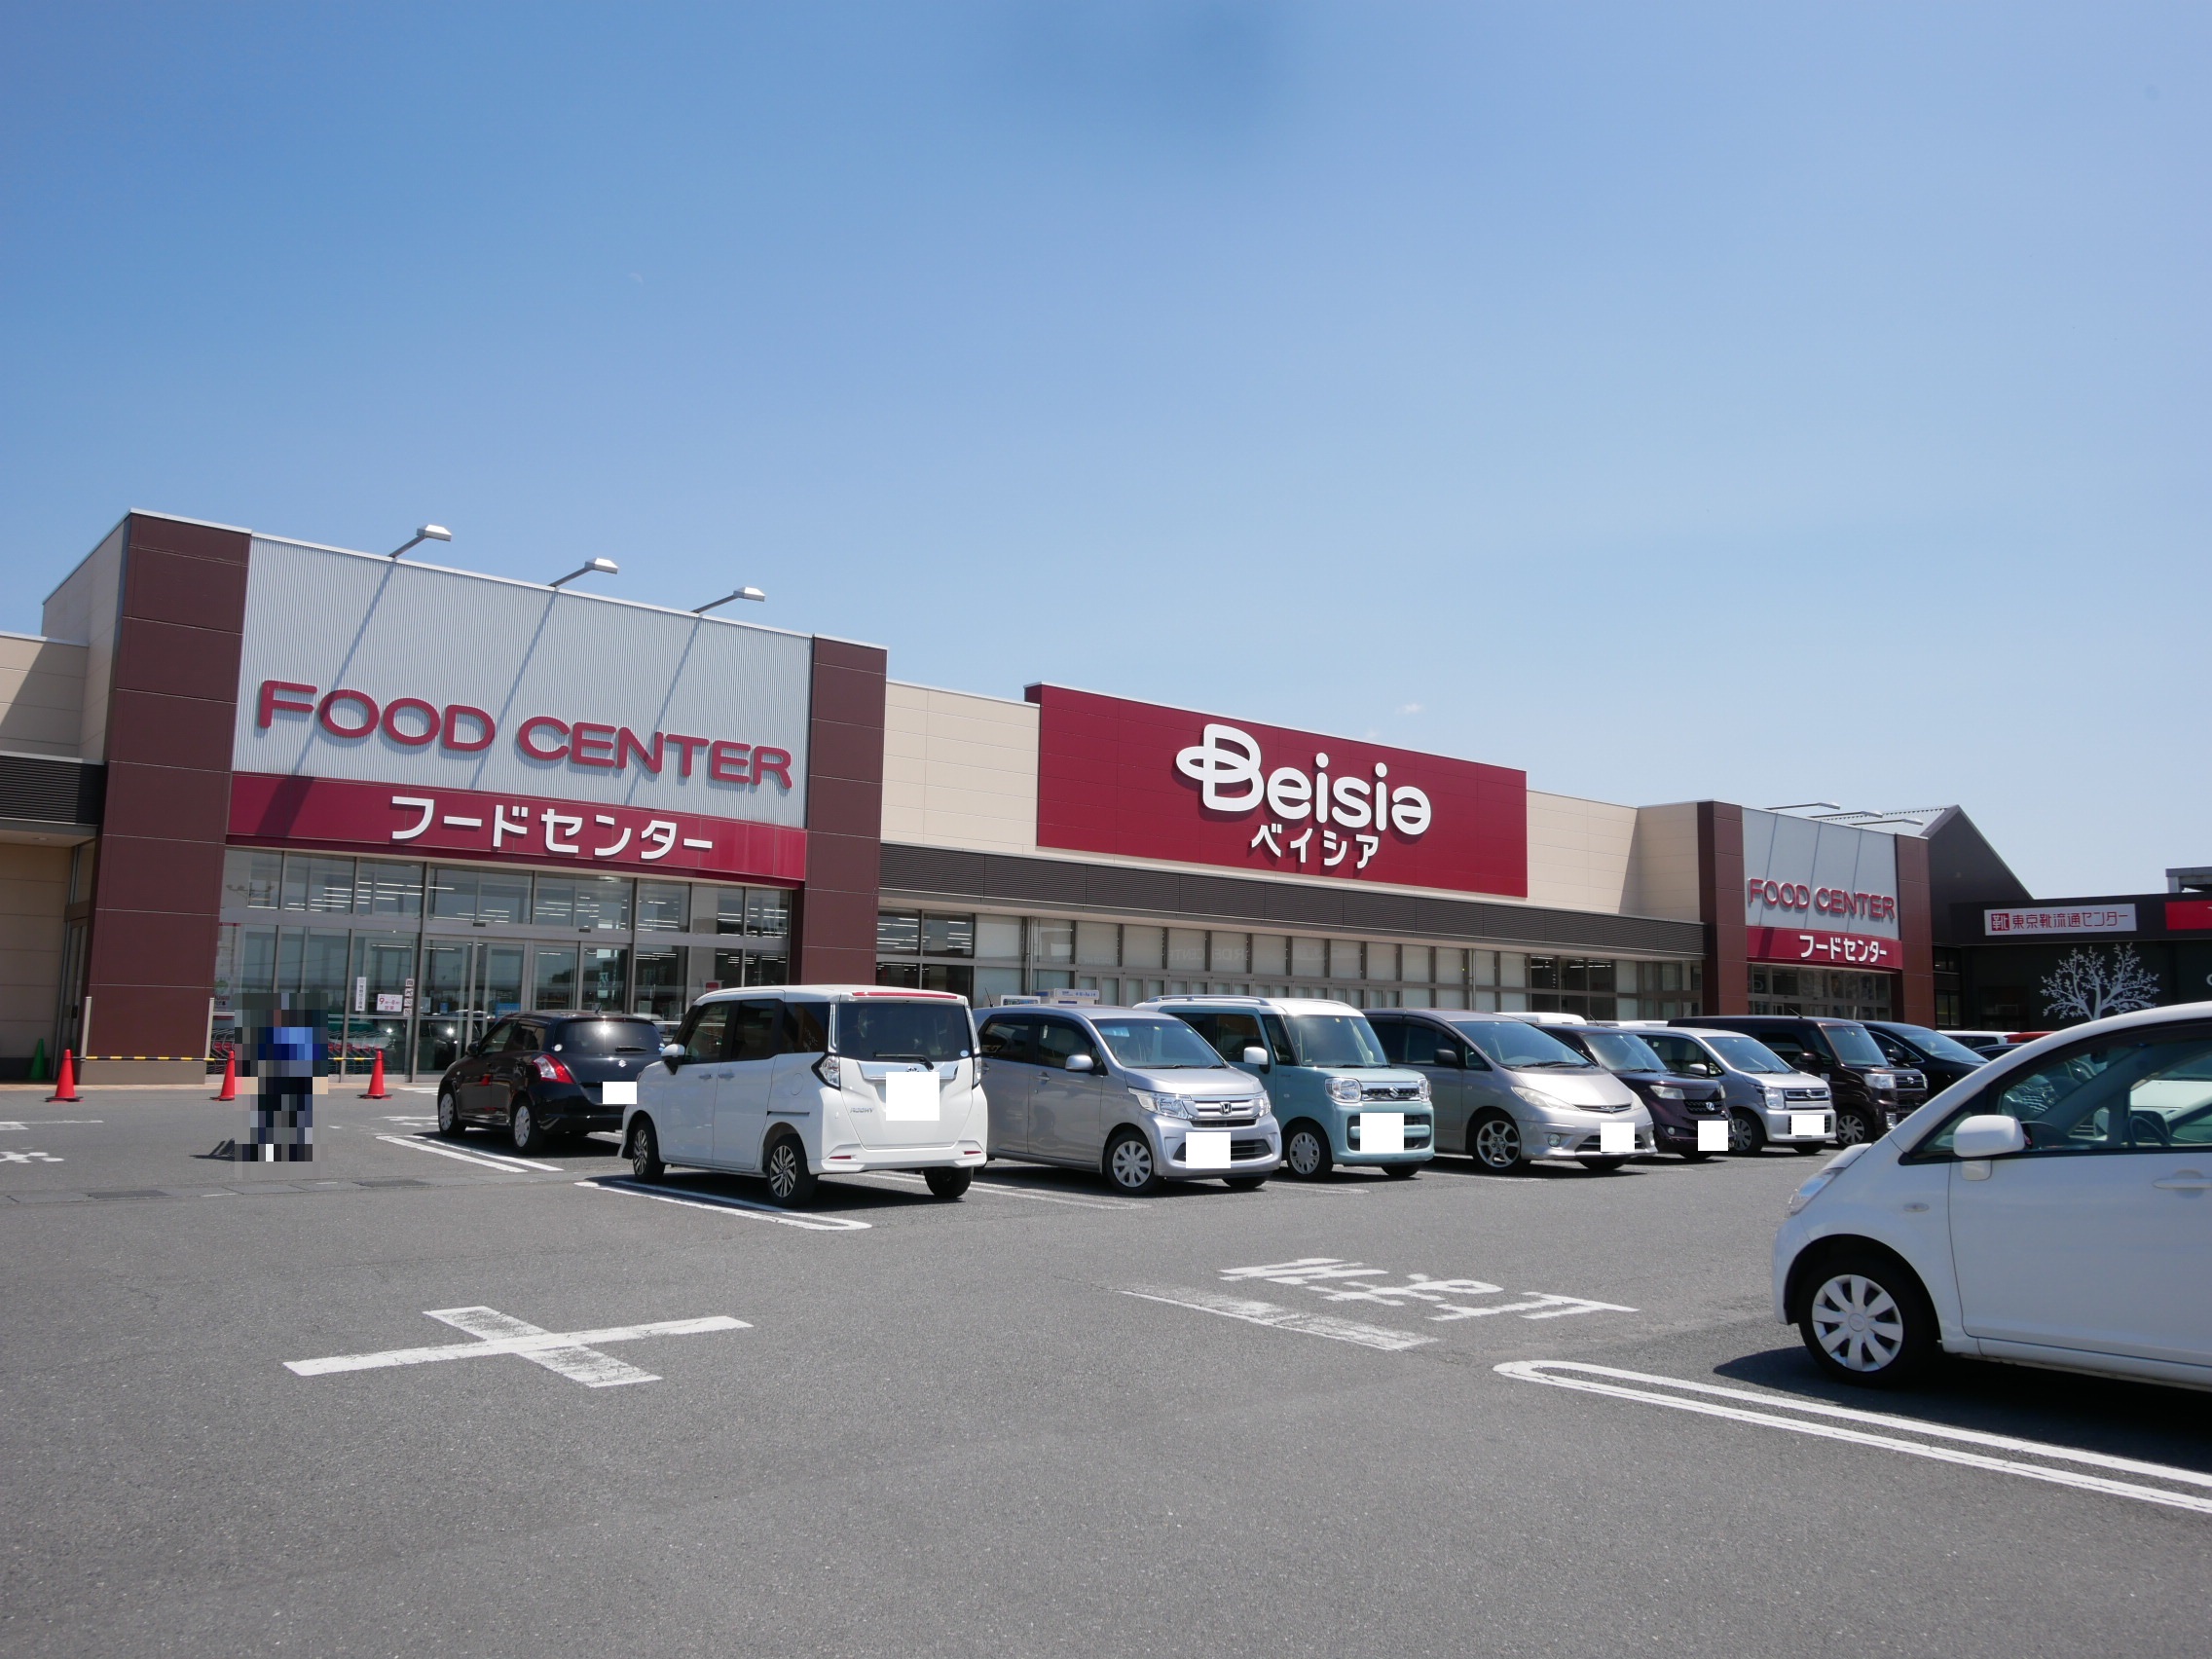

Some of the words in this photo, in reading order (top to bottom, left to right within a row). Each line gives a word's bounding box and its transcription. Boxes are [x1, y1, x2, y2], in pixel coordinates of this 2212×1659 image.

[257, 680, 496, 752] FOOD
[517, 716, 793, 790] CENTER
[1176, 723, 1432, 835] Beisia
[391, 795, 713, 860] フードセンター
[1251, 823, 1379, 869] ベイシア
[1748, 878, 1810, 909] FOOD
[1815, 887, 1896, 919] CENTER
[2011, 912, 2129, 929] 東京靴流通センター
[1799, 935, 1887, 963] フードセンター
